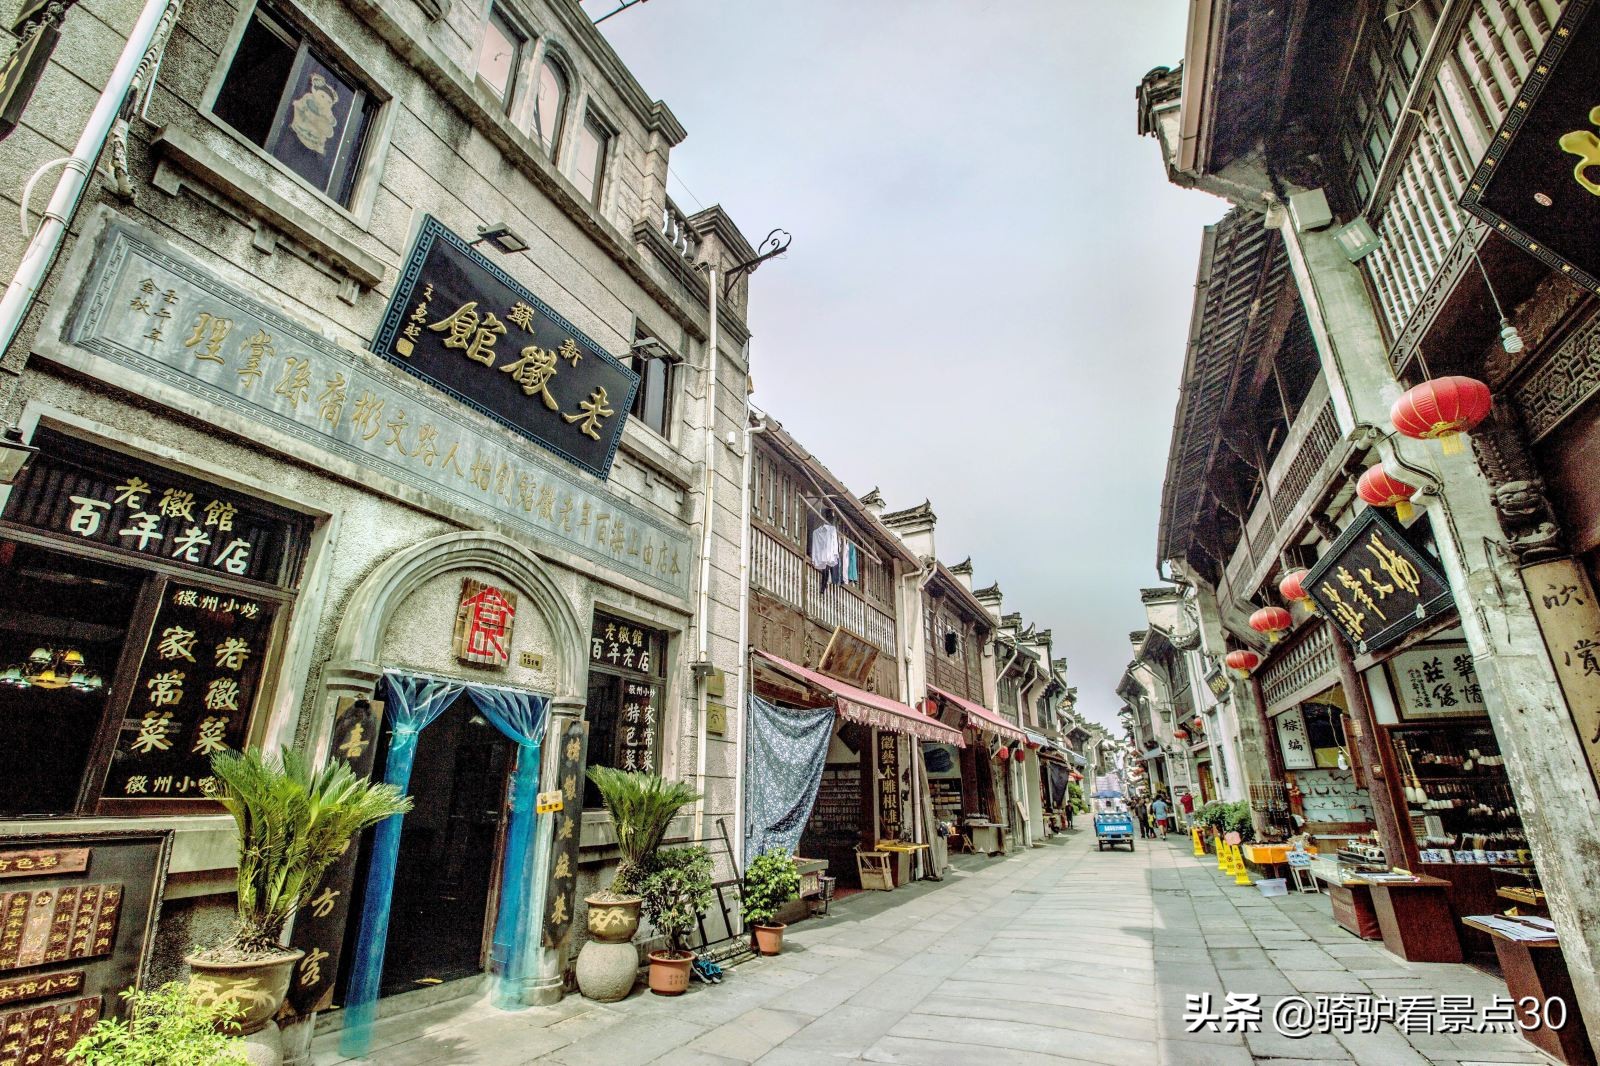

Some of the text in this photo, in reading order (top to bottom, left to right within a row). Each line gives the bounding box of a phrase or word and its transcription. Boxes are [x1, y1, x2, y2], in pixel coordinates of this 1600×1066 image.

[68, 495, 251, 575] 百年老店
[176, 590, 260, 620] 徽州小炒
[591, 637, 650, 672] 百年老店
[131, 626, 198, 754] 家常菜
[623, 703, 641, 772] 特色菜
[641, 703, 656, 772] 家常菜
[125, 774, 217, 796] 徽州小吃
